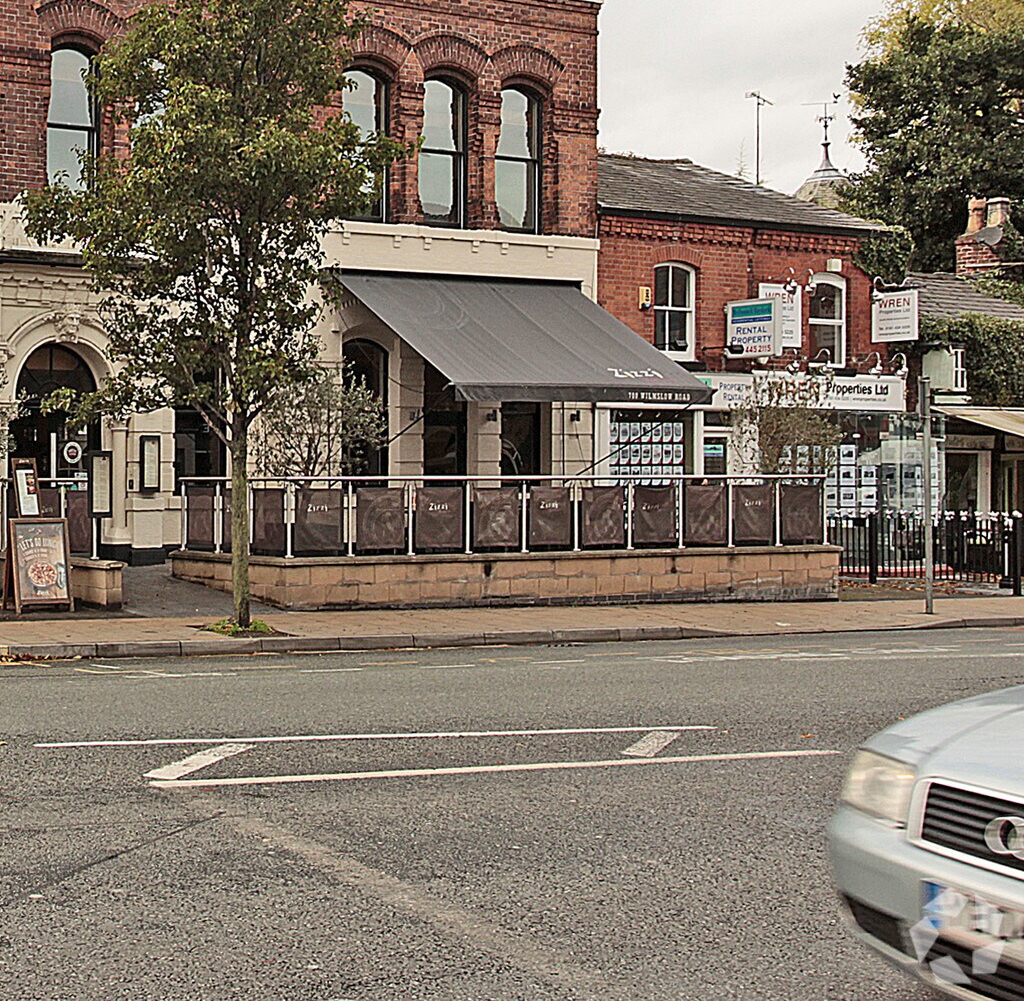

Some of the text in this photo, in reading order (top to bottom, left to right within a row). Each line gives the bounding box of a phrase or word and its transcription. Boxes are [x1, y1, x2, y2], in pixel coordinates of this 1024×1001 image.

[878, 298, 911, 308] WREN
[736, 326, 768, 335] RENTAL
[731, 335, 772, 345] PROPERTY
[607, 368, 664, 378] Zizzi
[826, 382, 872, 396] Properties
[875, 384, 889, 395] Ltd
[640, 392, 673, 400] WILMSLOW
[674, 393, 691, 401] ROAD
